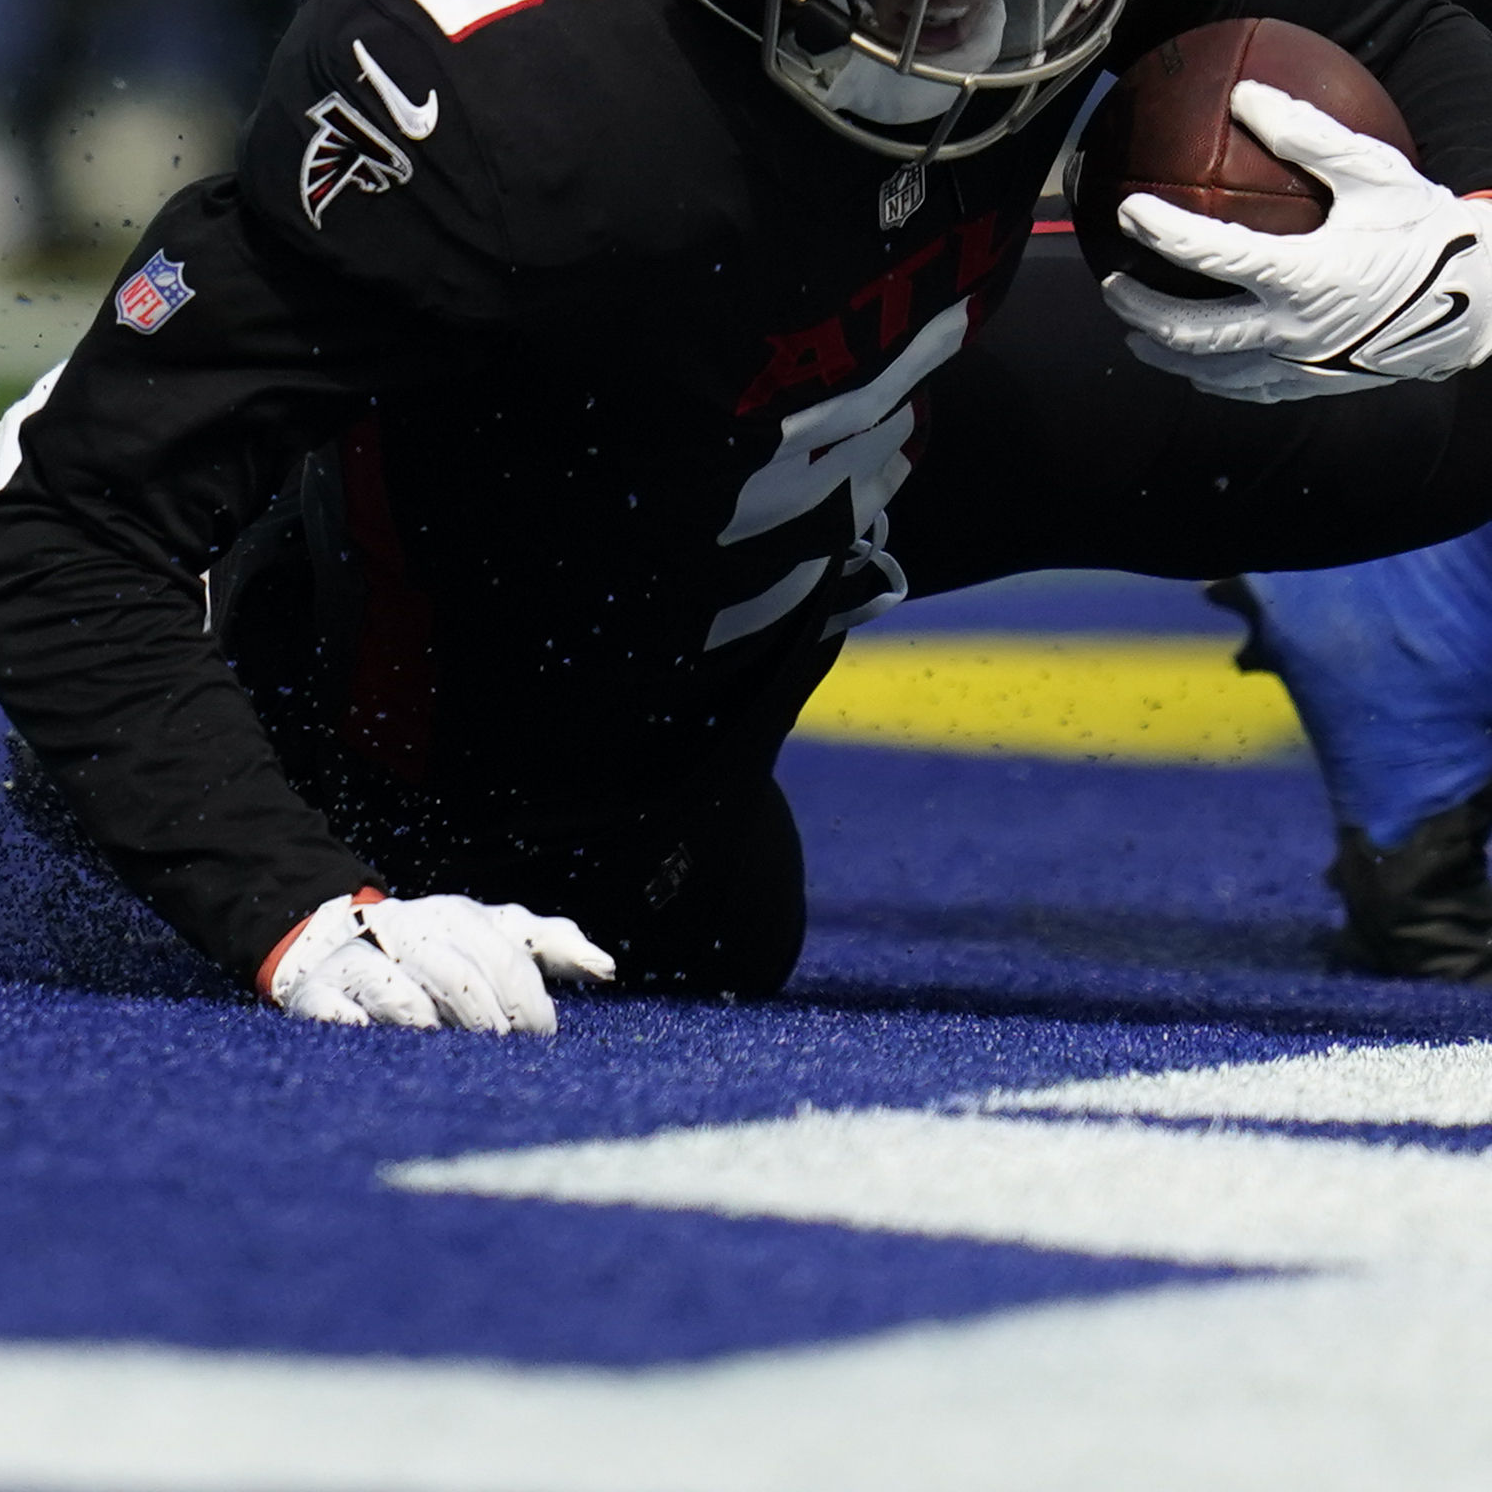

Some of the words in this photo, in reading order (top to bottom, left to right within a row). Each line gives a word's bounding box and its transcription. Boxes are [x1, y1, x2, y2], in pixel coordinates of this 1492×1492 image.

[888, 182, 923, 220] NFL
[123, 275, 163, 325] NFL
[733, 210, 1015, 417] ATL
